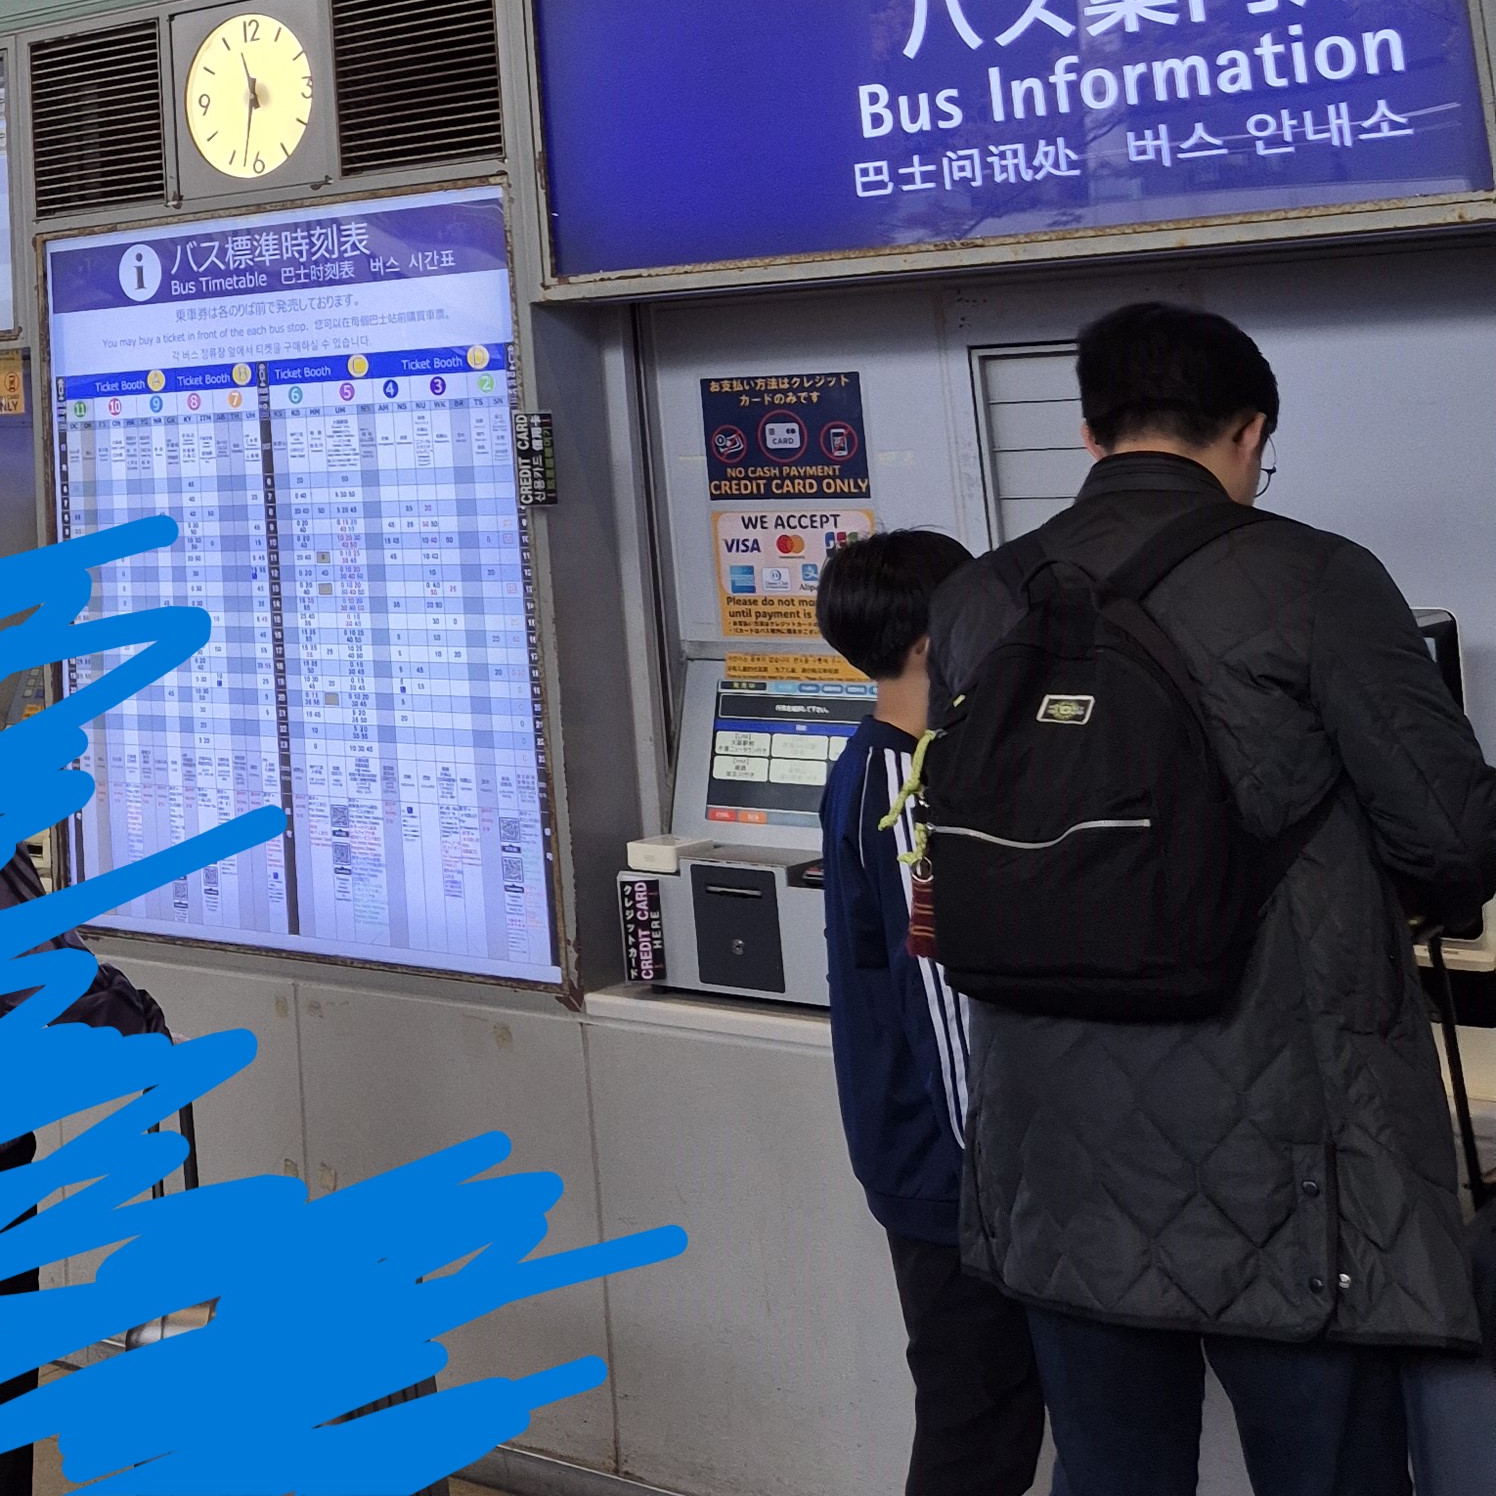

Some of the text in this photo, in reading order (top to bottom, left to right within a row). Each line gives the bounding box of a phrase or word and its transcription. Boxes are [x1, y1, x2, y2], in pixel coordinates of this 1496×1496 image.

[243, 19, 260, 43] 12
[301, 75, 313, 99] 3
[856, 24, 1407, 140] Bus Information
[198, 93, 211, 116] 9
[1126, 97, 1415, 168] 버스 안내소
[253, 151, 266, 174] 6
[853, 134, 1082, 199] 巴士问讯处
[171, 221, 372, 276] バス標準時刻表
[280, 259, 356, 285] 巴士时刻表
[369, 249, 456, 275] 버스 시간표
[171, 271, 268, 296] Bus Timetable
[103, 338, 118, 349] You
[119, 337, 137, 348] may
[138, 334, 154, 347] buy
[162, 332, 185, 344] ticket
[197, 330, 217, 340] front
[230, 327, 244, 337] the
[246, 325, 266, 336] each
[269, 324, 285, 334] bus
[183, 348, 199, 360] 버스
[401, 356, 463, 370] Ticket Booth
[177, 372, 230, 386] Ticket Booth
[274, 366, 331, 380] Ticket Booth
[709, 374, 850, 393] お支払い方法はクレジット
[95, 378, 146, 392] Ticket Booth
[739, 391, 821, 406] カードのみです
[772, 437, 794, 445] CARD
[515, 414, 534, 504] CREDIT CARD
[532, 455, 546, 503] 신용카드
[726, 465, 841, 478] NO CASH PAYMENT
[710, 478, 869, 495] CREDIT CARD ONLY
[741, 514, 841, 530] WE ACCEPT
[724, 538, 761, 553] VISA
[726, 596, 817, 607] Please do not mo
[729, 608, 812, 621] until payment is
[623, 884, 638, 980] クレジットカード
[634, 881, 654, 980] CREDIT CARD
[650, 910, 663, 949] HERE
